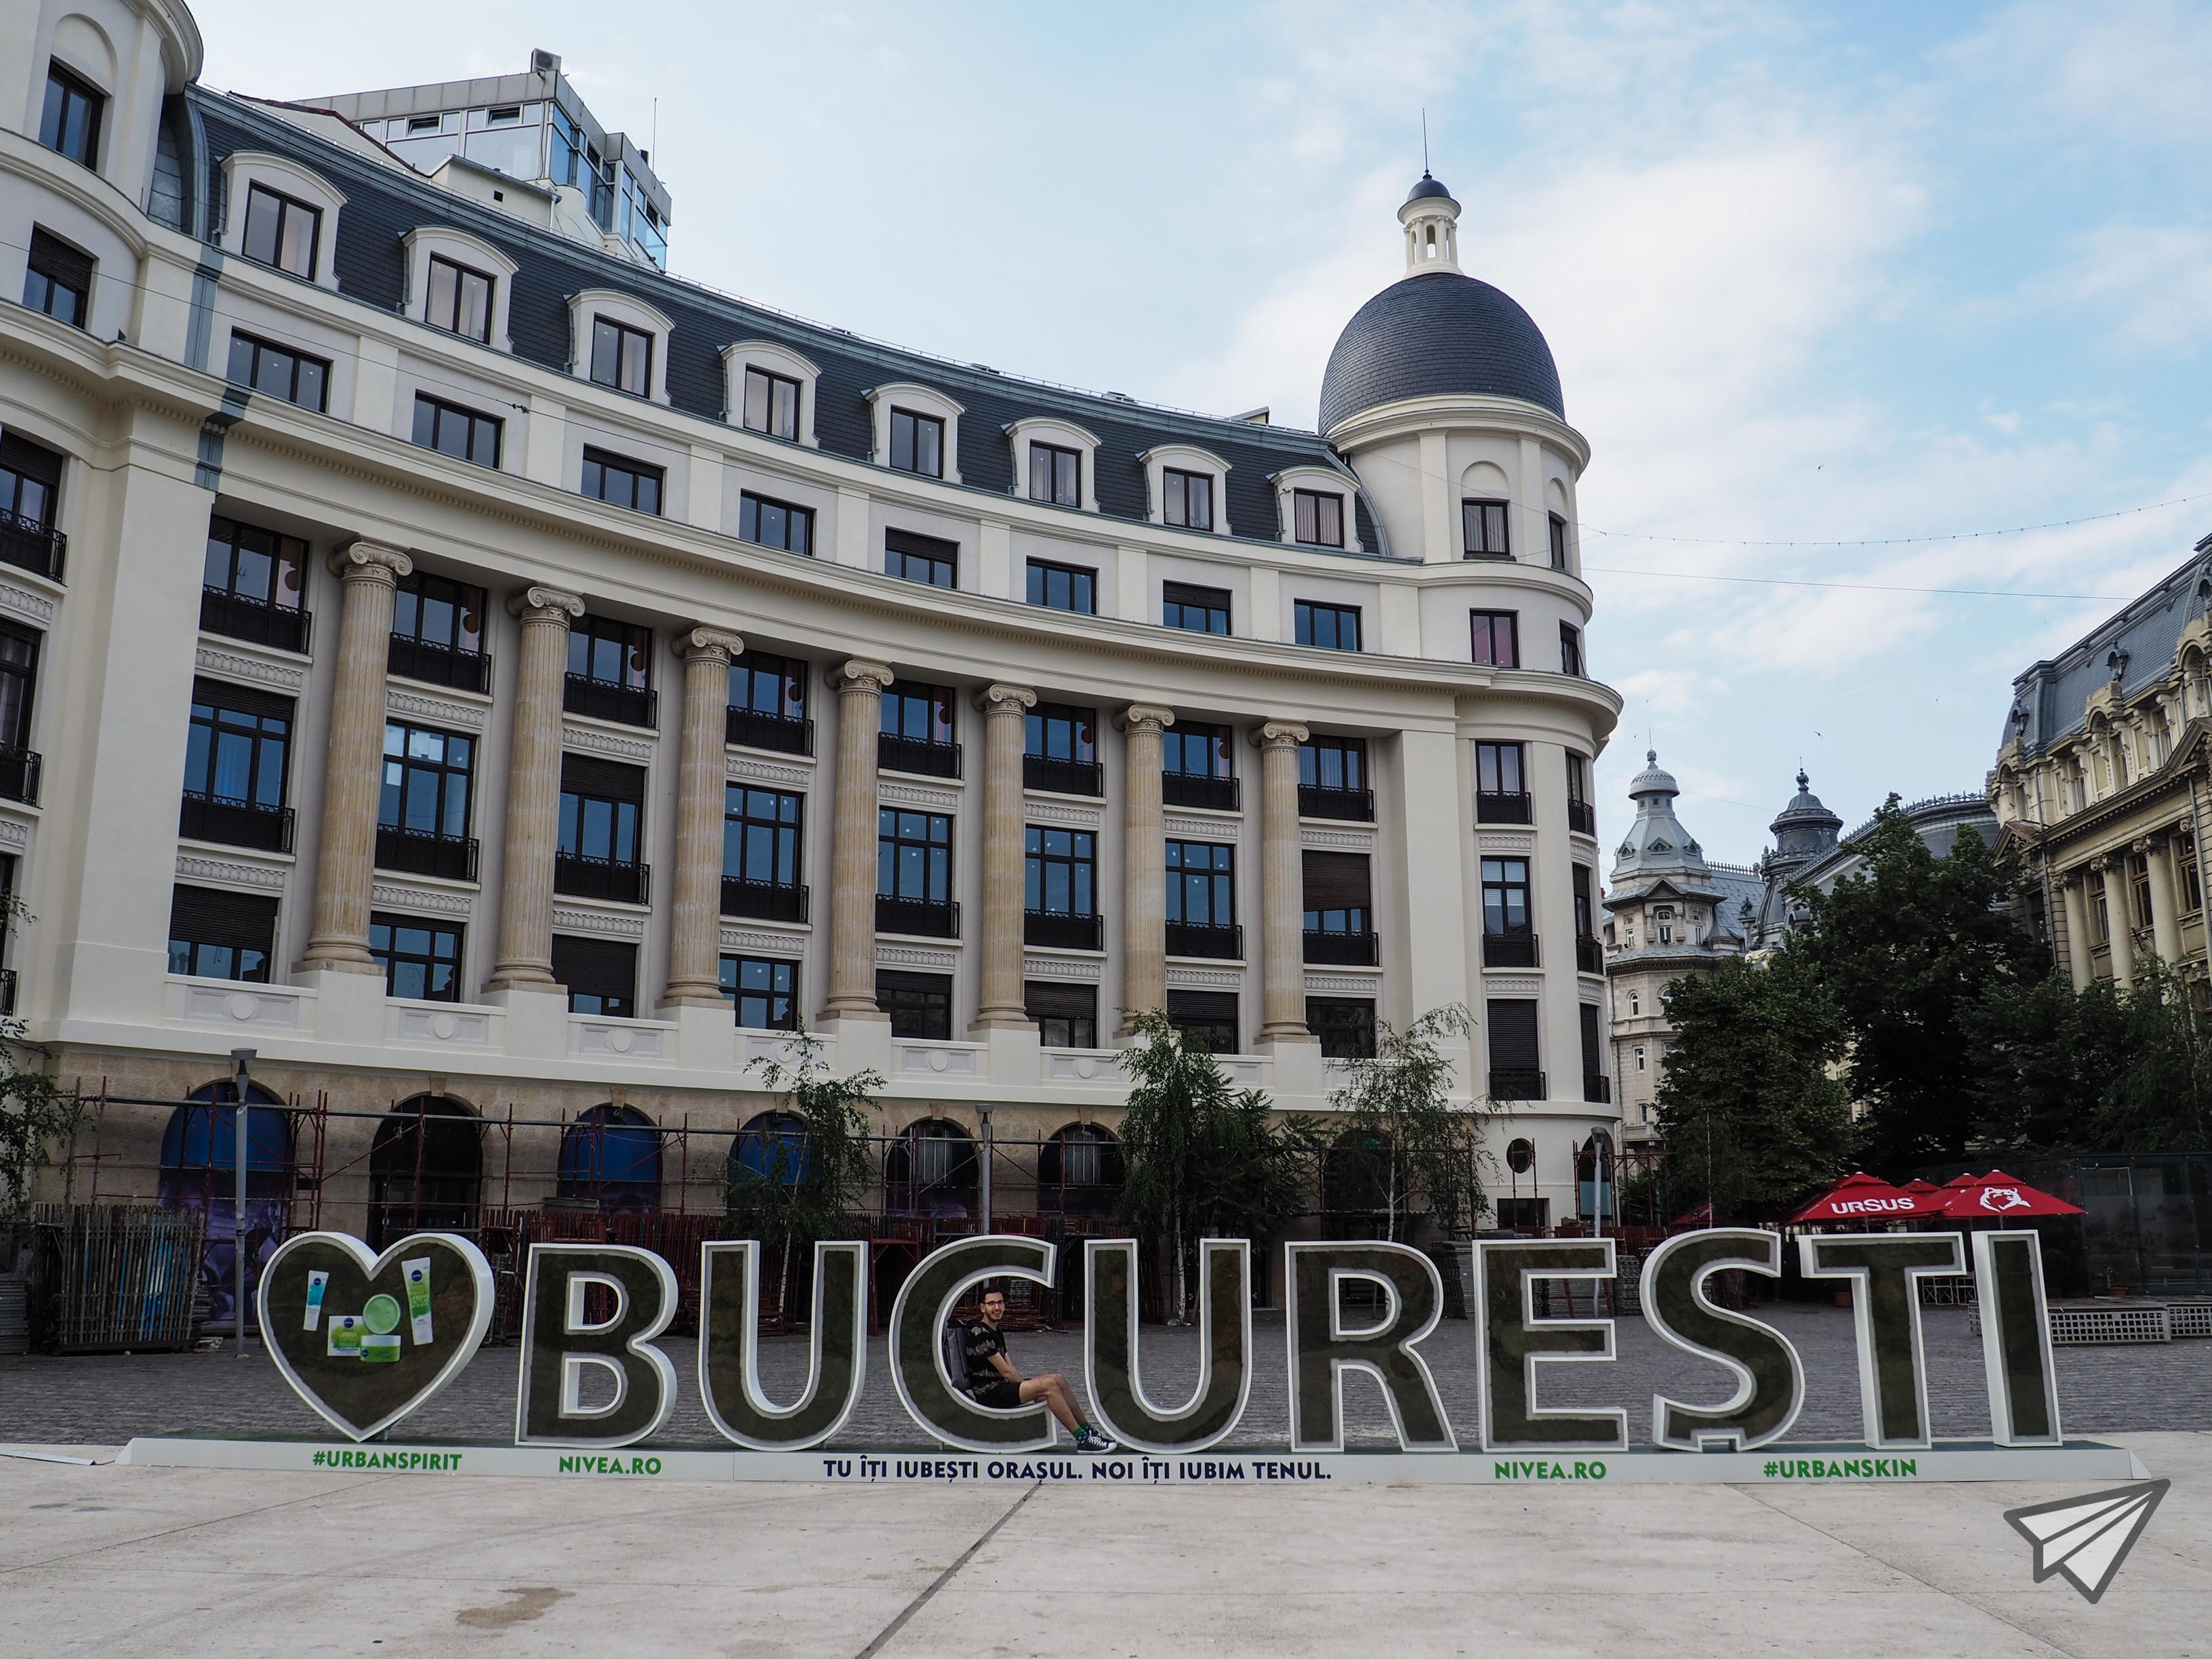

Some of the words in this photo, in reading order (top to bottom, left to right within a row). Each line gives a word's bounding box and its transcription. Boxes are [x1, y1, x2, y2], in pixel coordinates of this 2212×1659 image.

[1830, 1197, 1915, 1214] URSUS
[312, 1450, 462, 1470] #URBANSPIRIT
[558, 1456, 662, 1475] NIVEA.RO
[1763, 1459, 1918, 1477] #URBANSKIN
[823, 1460, 852, 1477] TU
[1092, 1461, 1133, 1479] NOI
[1179, 1461, 1245, 1479] IUBIM
[1252, 1461, 1332, 1479] TENUL.
[1494, 1461, 1607, 1479] NIVEA.RO
